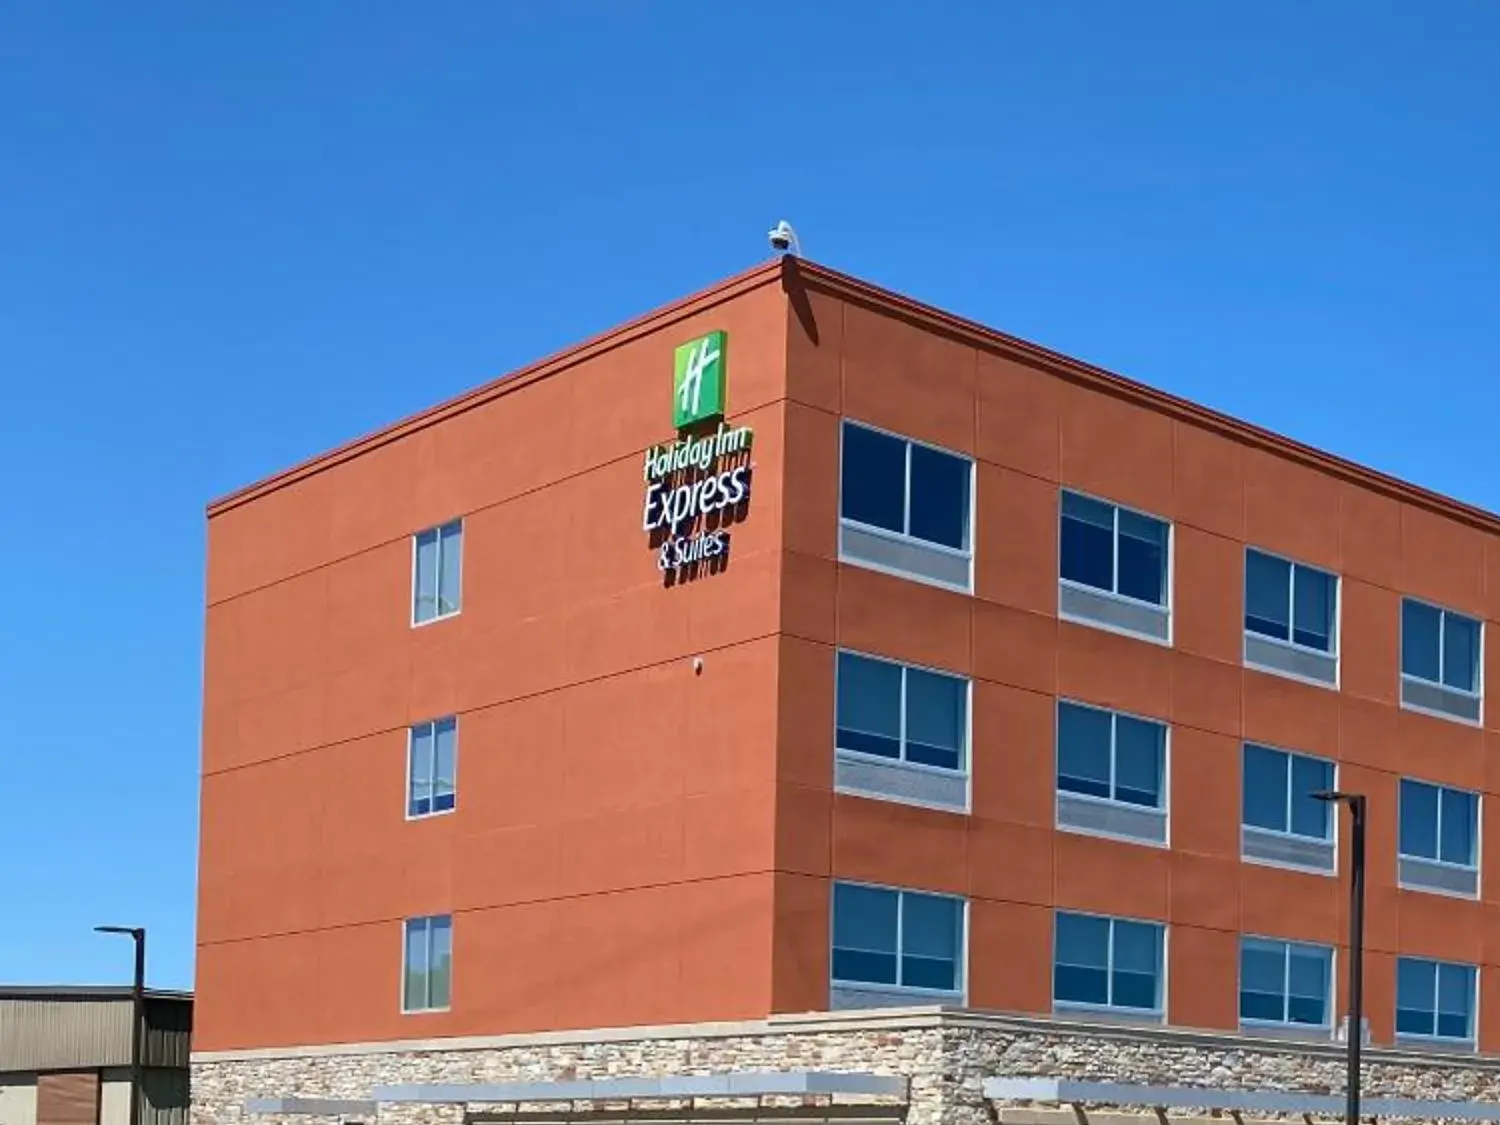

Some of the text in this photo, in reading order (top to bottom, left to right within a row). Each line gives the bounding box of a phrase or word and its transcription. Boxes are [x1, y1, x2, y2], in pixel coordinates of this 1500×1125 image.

[644, 422, 752, 481] Holiday Inn
[643, 466, 745, 534] Express
[657, 531, 724, 571] & Suites
